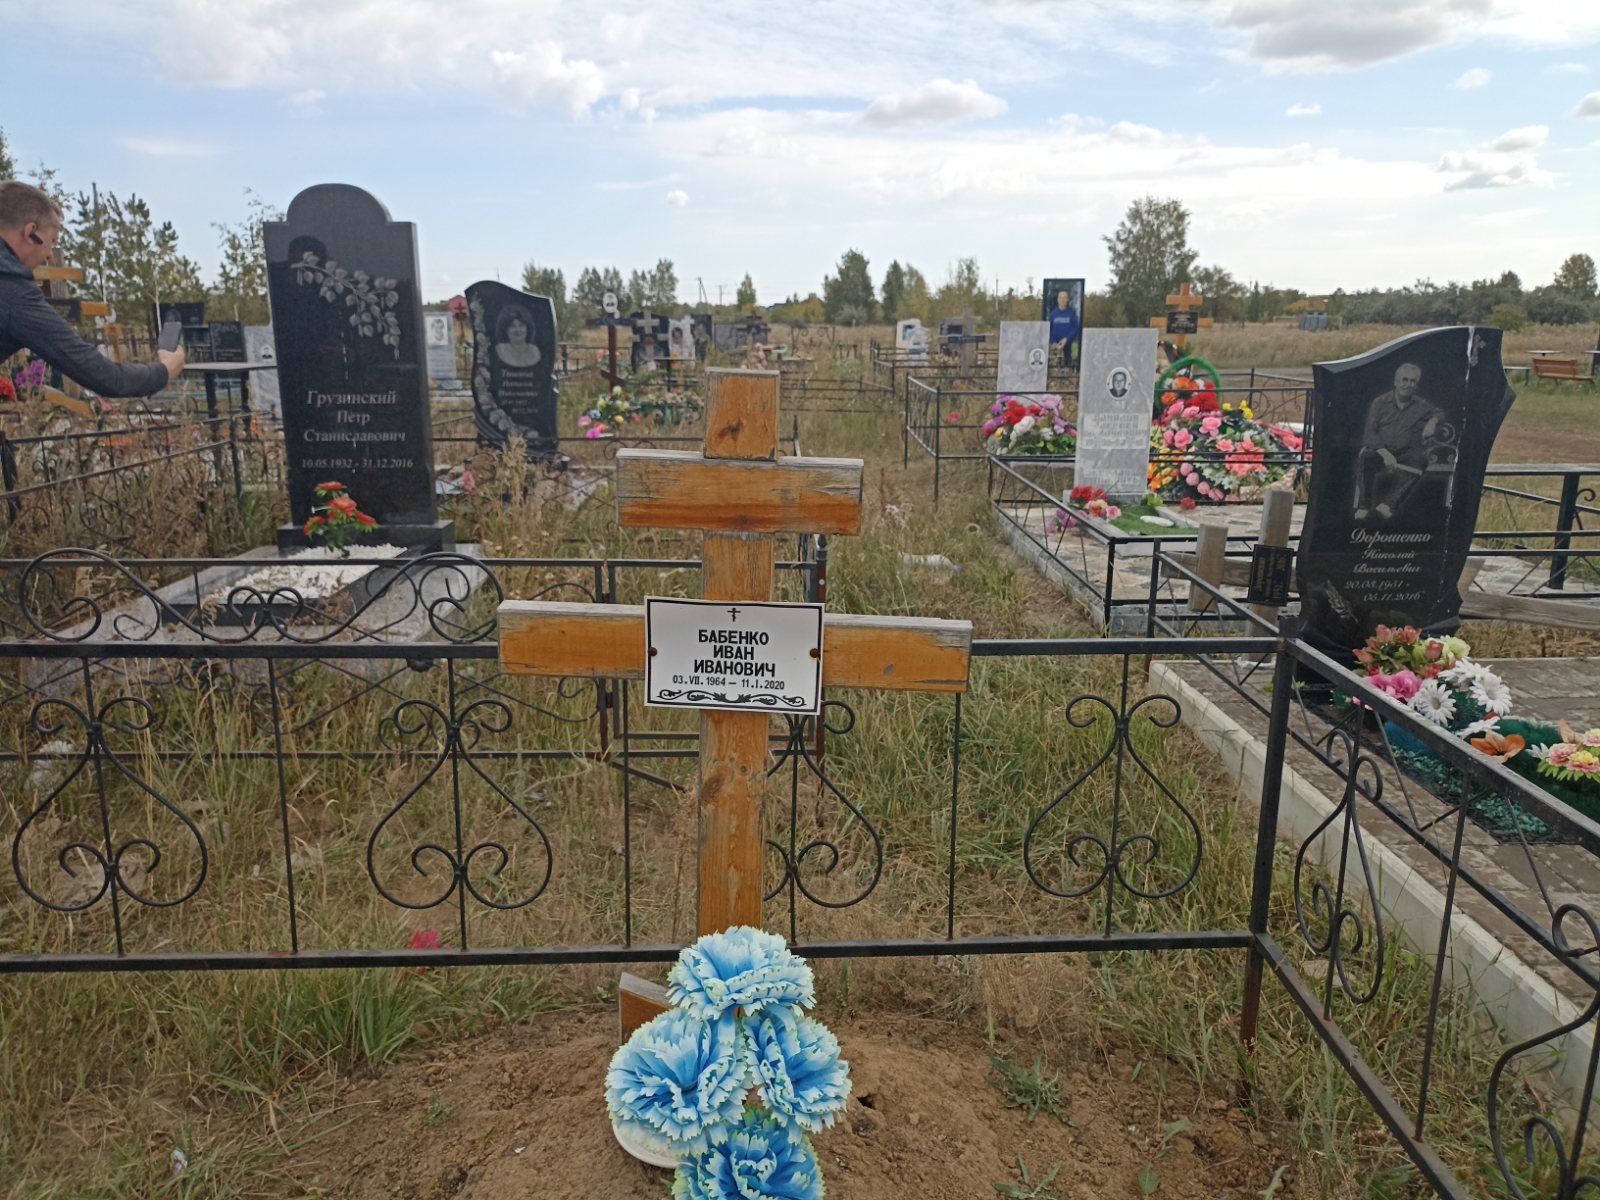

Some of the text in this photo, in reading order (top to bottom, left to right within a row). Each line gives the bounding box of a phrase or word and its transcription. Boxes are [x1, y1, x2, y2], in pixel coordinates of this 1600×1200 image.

[307, 390, 397, 407] Грузинский
[304, 429, 406, 442] Станиславович
[302, 458, 353, 468] 10.05.1932
[362, 458, 414, 468] 31.12.2016
[1350, 527, 1431, 548] Дорошенко
[1361, 549, 1416, 559] Николай
[1353, 562, 1421, 573] Васильевич
[1363, 590, 1425, 602] 05.11.2016
[698, 629, 769, 645] БАБЕНКО
[713, 645, 754, 660] ИВАН
[694, 659, 775, 677] ИВАНОВИЧ
